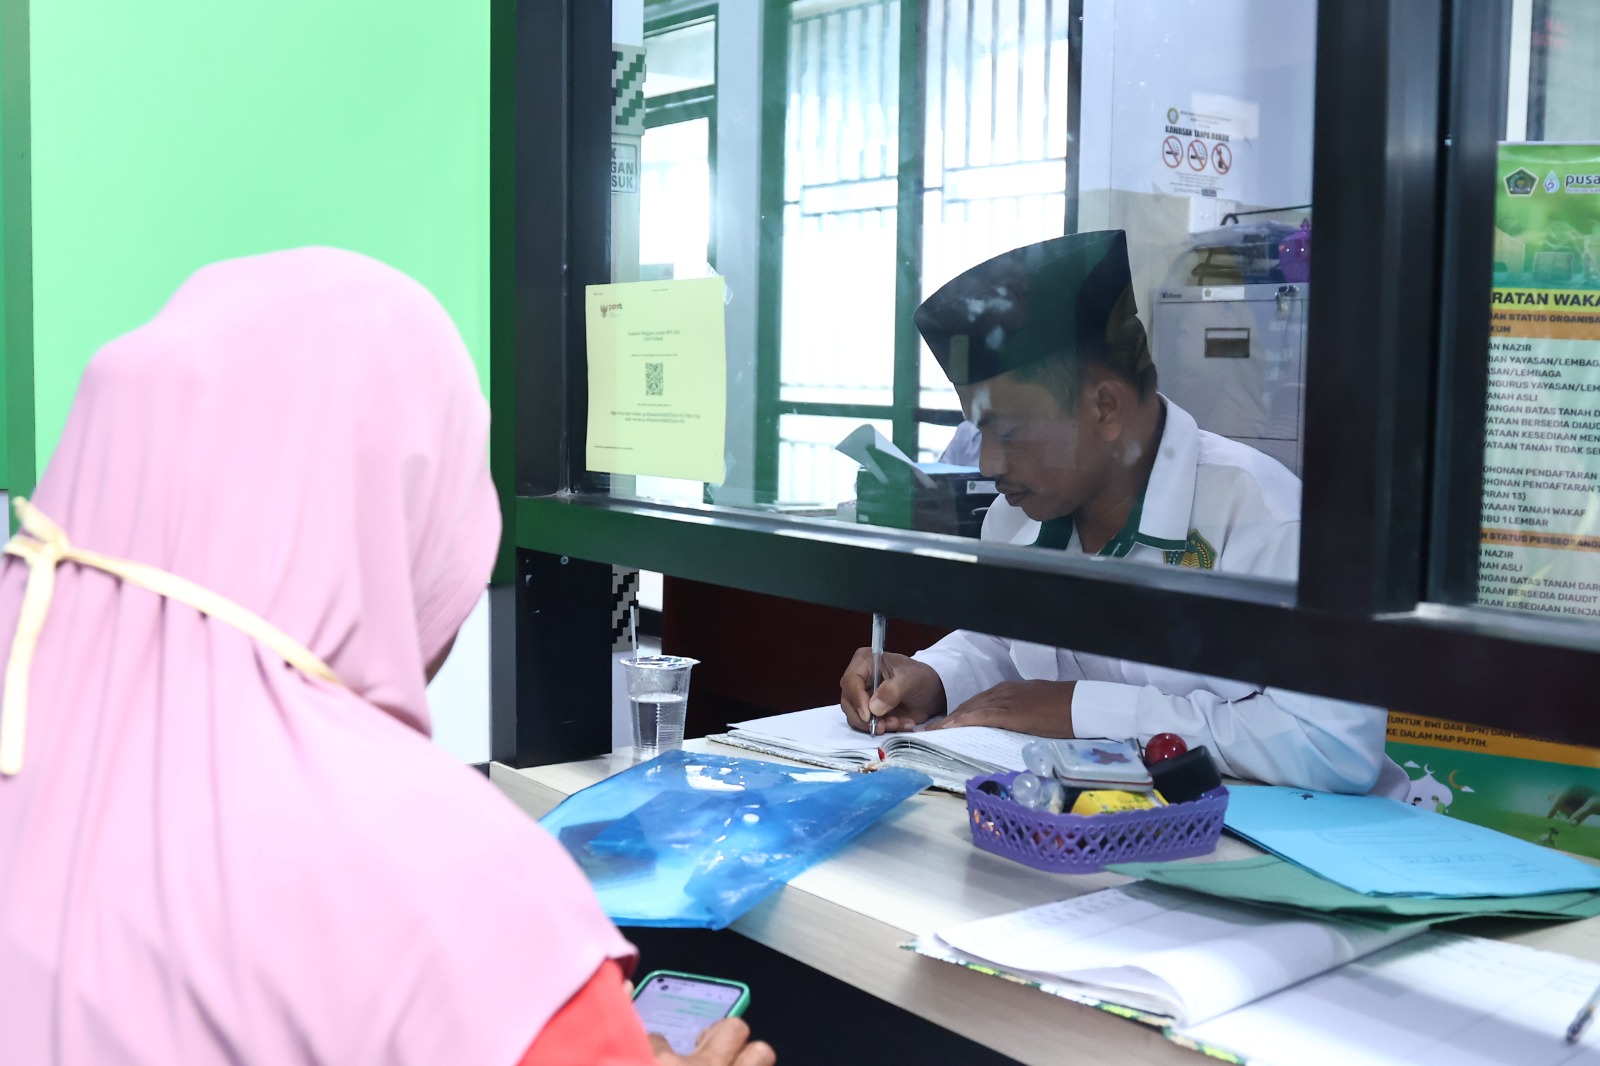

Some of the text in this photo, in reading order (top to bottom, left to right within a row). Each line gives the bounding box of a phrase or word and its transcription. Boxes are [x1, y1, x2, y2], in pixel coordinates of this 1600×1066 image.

[611, 161, 633, 175] GAN
[611, 175, 633, 189] SUK
[1493, 292, 1549, 305] RATAN
[1510, 314, 1547, 322] STATUS
[1508, 356, 1600, 367] YAYASAN/LEMBAG
[1488, 380, 1529, 389] NGURUS
[1516, 393, 1538, 401] ASLI
[1525, 406, 1556, 415] BATAS
[1559, 408, 1591, 417] TANAH
[1521, 419, 1570, 428] BERSEDIA
[1522, 431, 1576, 440] KESEDIAAN
[1520, 443, 1552, 452] TANAH
[1555, 445, 1583, 454] TIDAK
[1586, 447, 1600, 455] SE
[1526, 468, 1597, 480] PENDAFTARAN
[1523, 481, 1594, 492] PENDAFTARAN
[1512, 492, 1526, 501] 13)
[1518, 505, 1550, 514] TANAH
[1552, 507, 1586, 517] WAKAF
[1509, 517, 1549, 526] LEMBAR
[1490, 533, 1529, 542] STATUS
[1485, 549, 1514, 558] NAZIR
[1501, 563, 1523, 572] ASLI
[1510, 576, 1541, 586] BATAS
[1543, 579, 1576, 589] TANAH
[1508, 588, 1556, 600] BERSEDIA
[1558, 592, 1598, 603] DIAUDIT
[1506, 601, 1561, 613] KESEDIAAN
[1564, 606, 1600, 617] MENJA
[1424, 720, 1441, 729] BWI
[1443, 722, 1463, 732] DAN
[1400, 729, 1432, 740] DALAM
[1434, 733, 1455, 742] MAP
